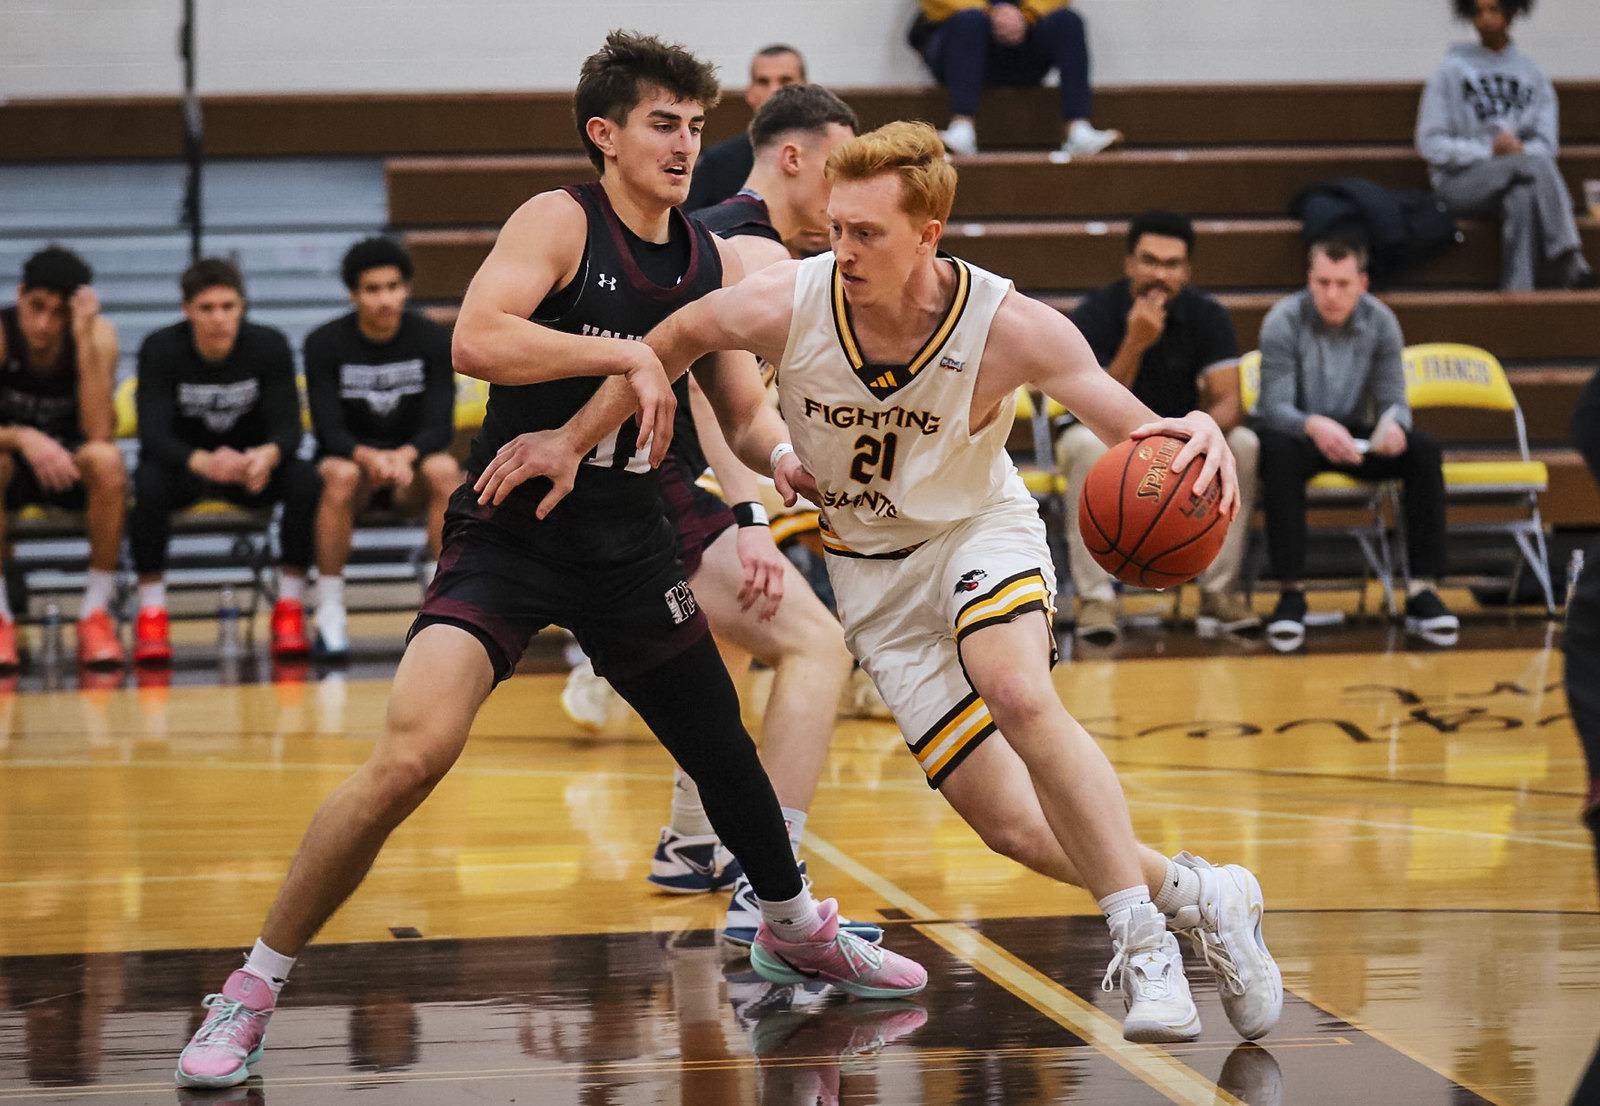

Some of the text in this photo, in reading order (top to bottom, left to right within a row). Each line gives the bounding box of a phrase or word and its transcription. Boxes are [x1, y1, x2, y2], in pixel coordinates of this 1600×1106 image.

[803, 396, 941, 435] FIGHTING
[850, 431, 899, 485] 21
[1137, 439, 1181, 504] SPALDI
[823, 489, 898, 519] SAINTS
